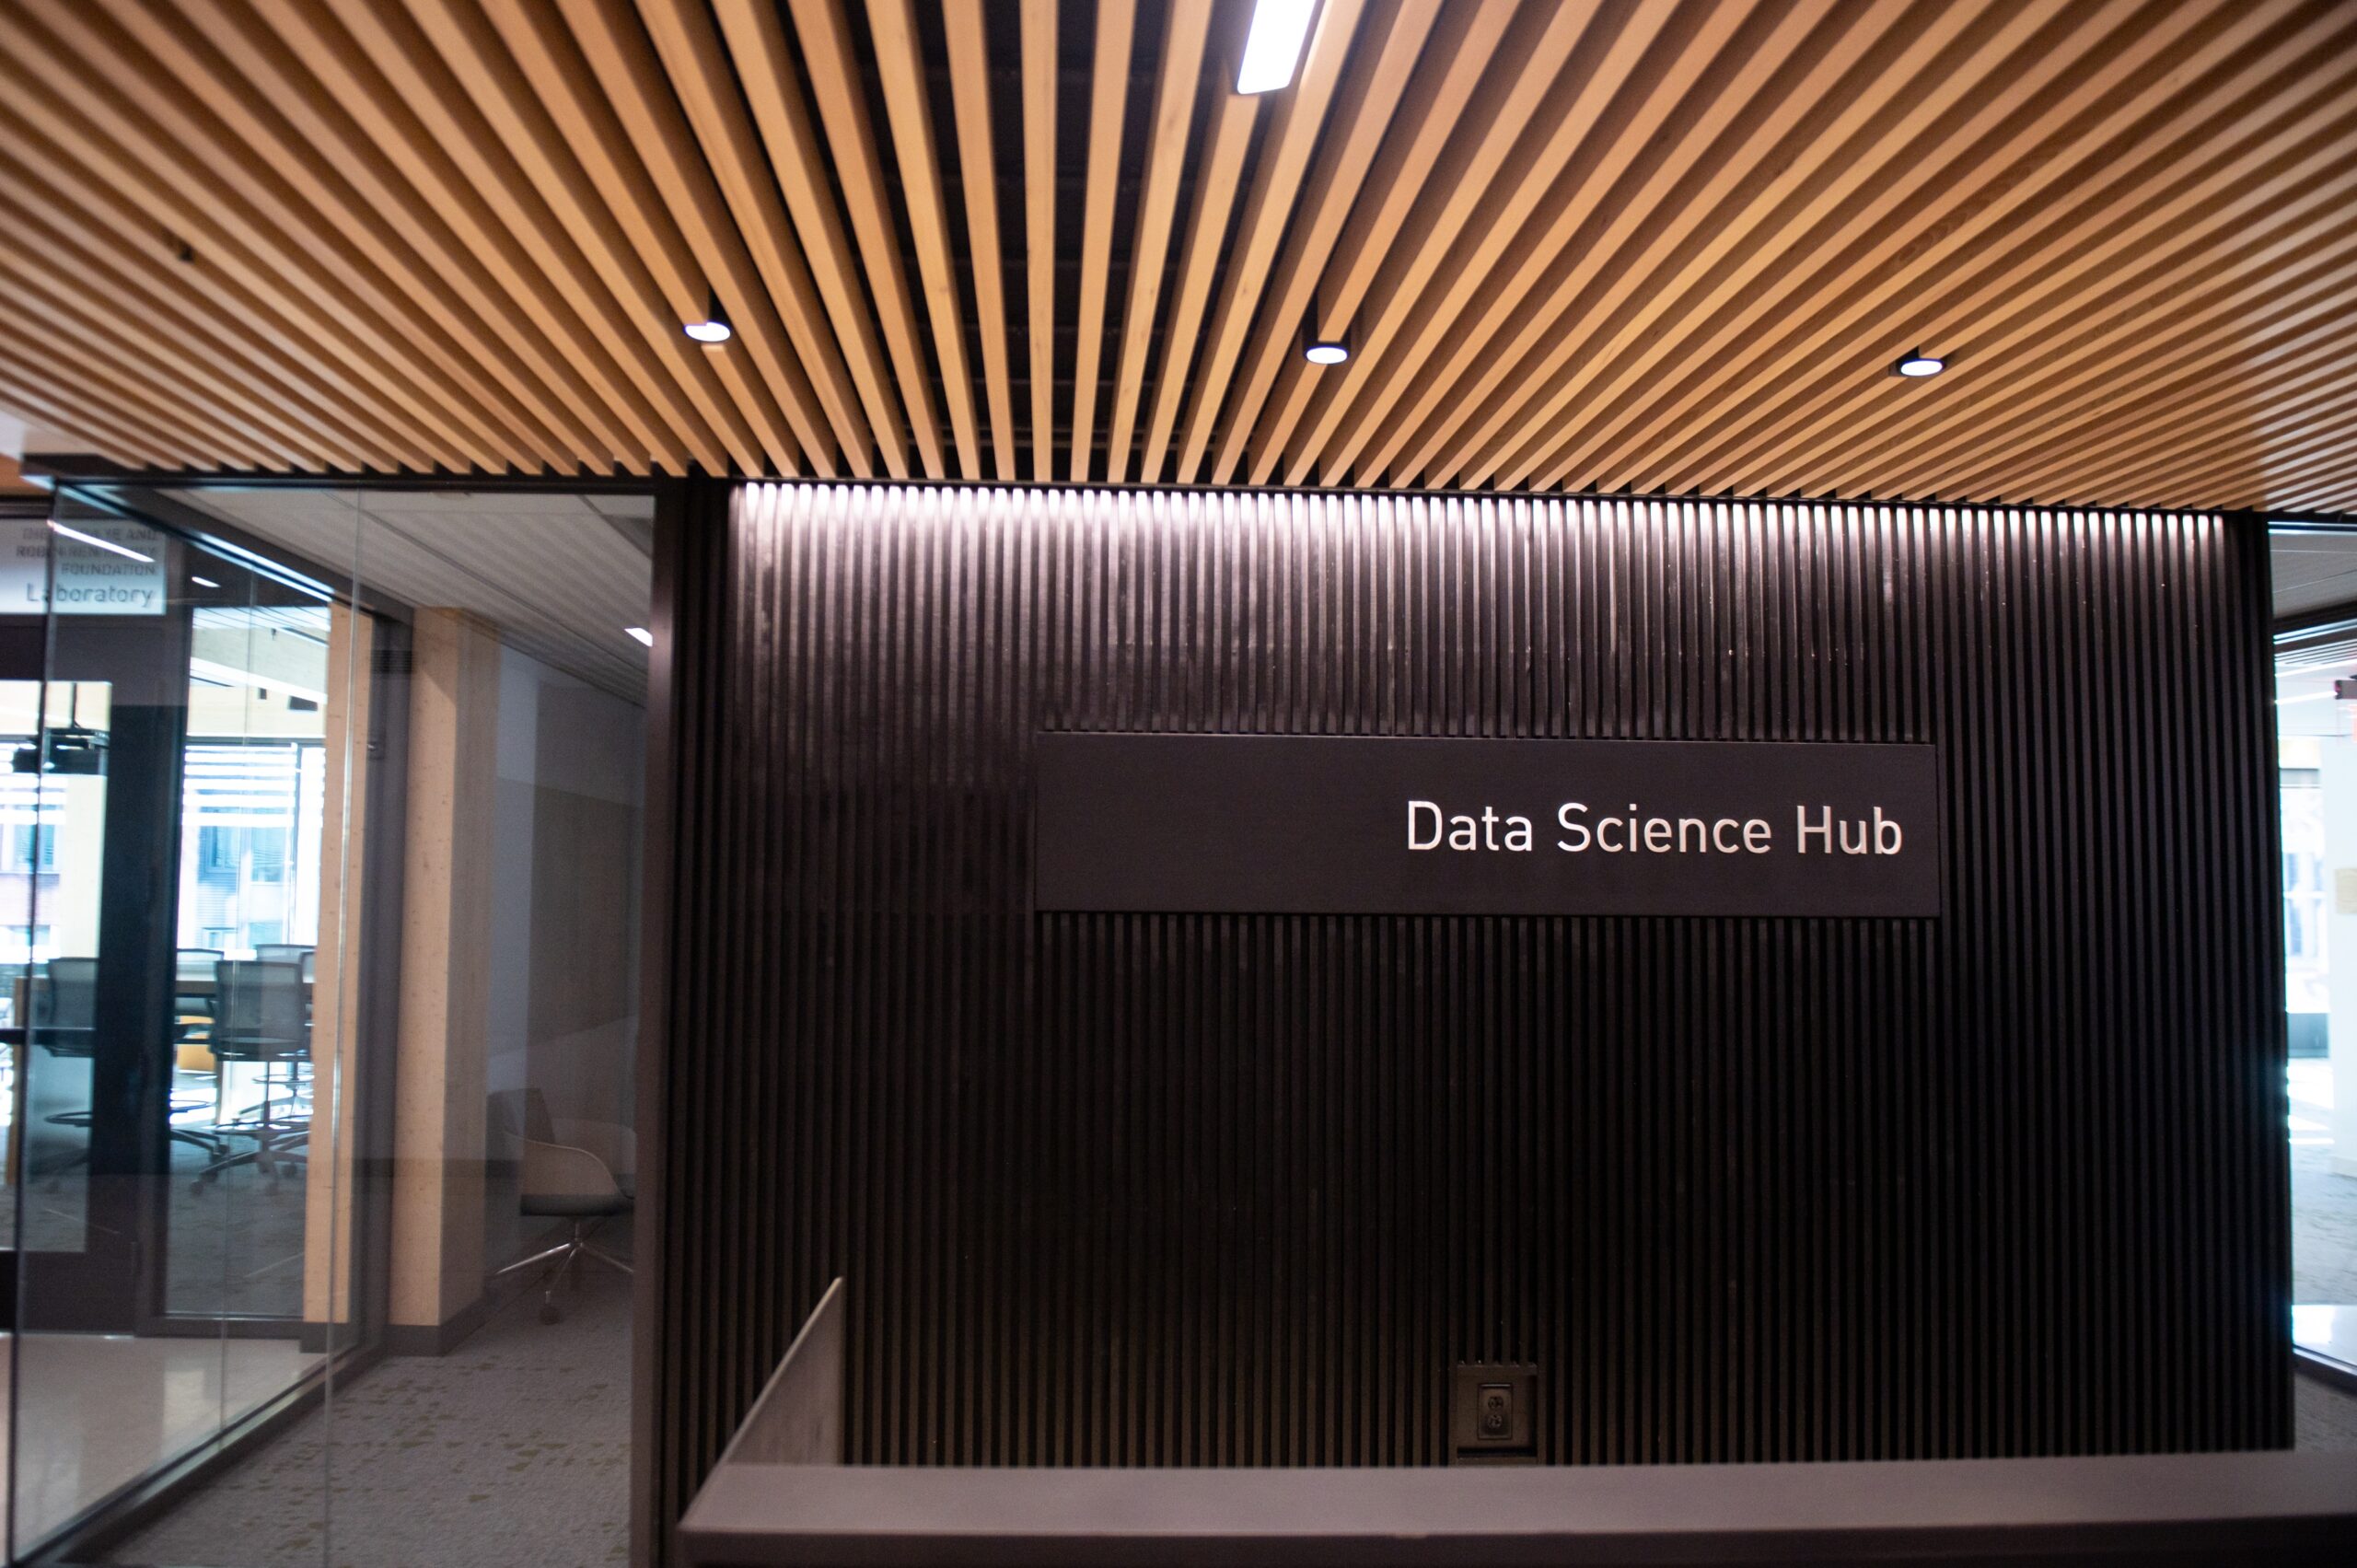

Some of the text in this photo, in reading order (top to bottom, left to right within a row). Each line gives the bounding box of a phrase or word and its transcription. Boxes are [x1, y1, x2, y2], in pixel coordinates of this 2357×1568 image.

[61, 562, 157, 575] FOUNDATION
[26, 582, 154, 609] Lboratory
[1407, 799, 1902, 854] Data Science Hub
